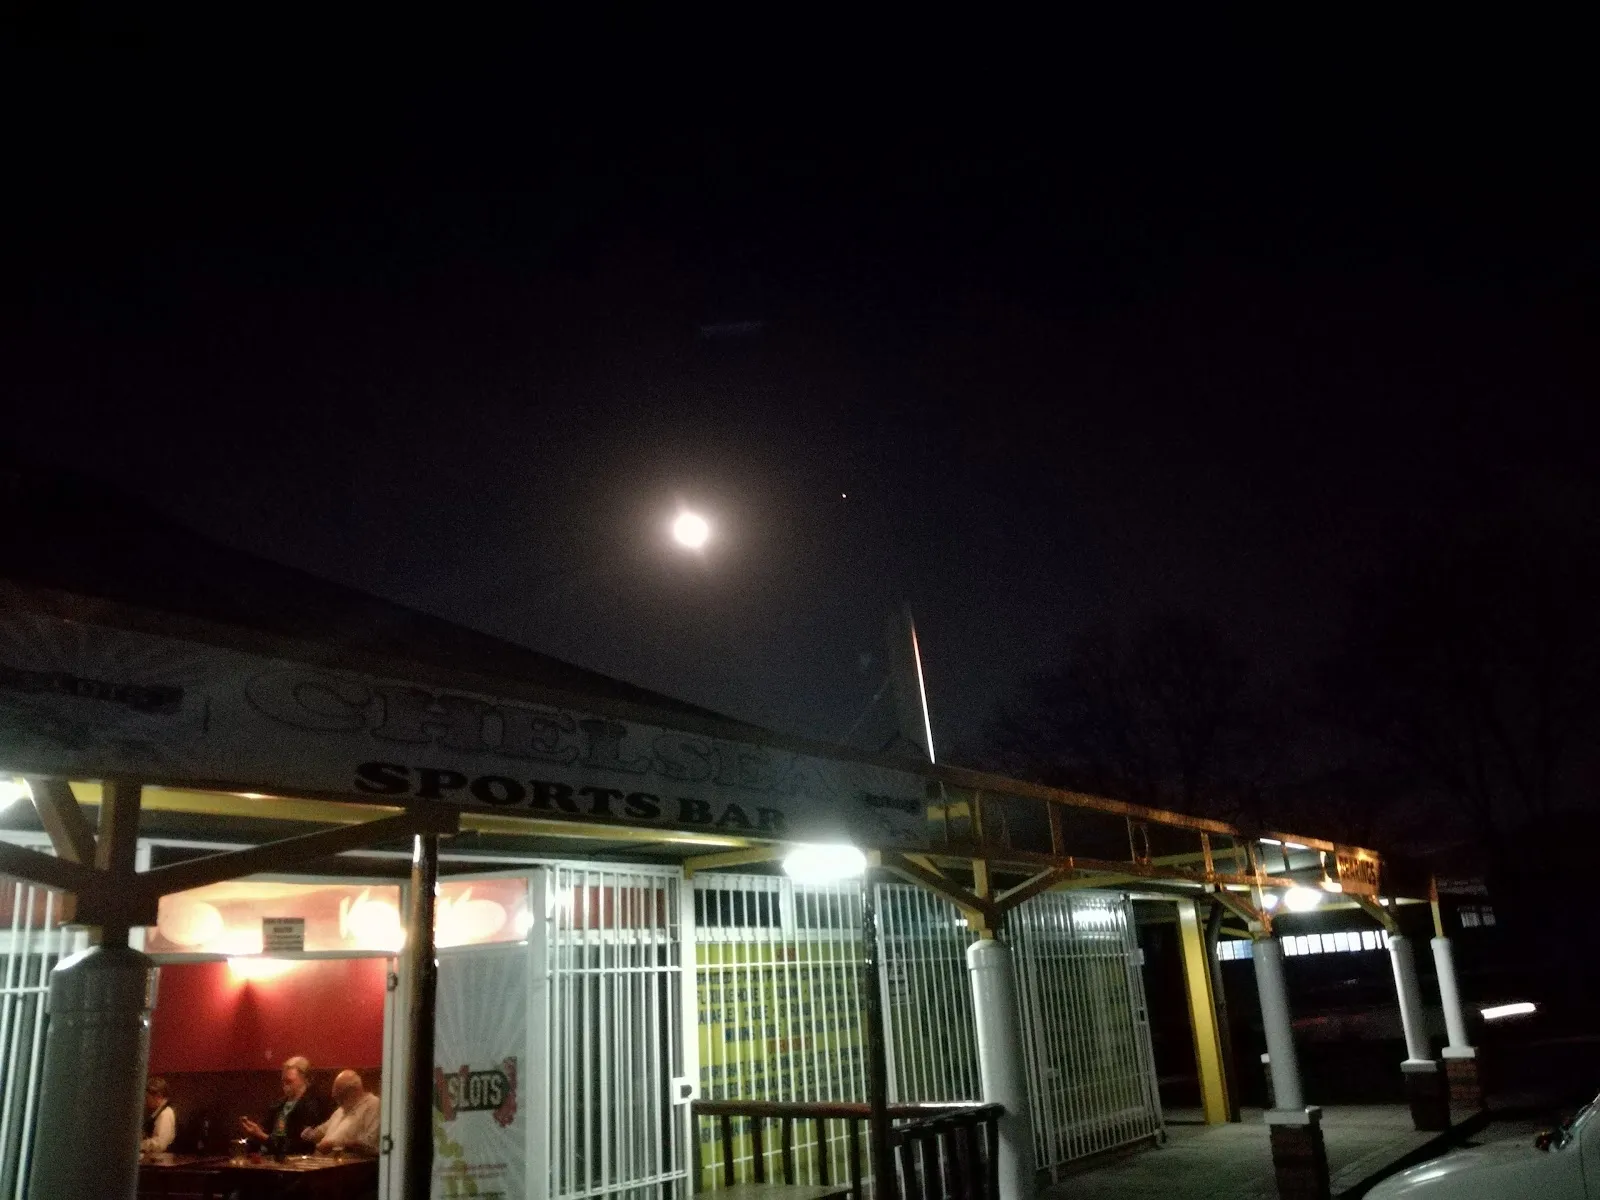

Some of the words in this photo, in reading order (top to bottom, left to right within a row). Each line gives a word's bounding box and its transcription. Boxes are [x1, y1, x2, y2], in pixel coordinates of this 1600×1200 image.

[246, 667, 841, 798] CHELSEA
[355, 762, 661, 819] SPORTS
[677, 798, 786, 831] BAR
[448, 1073, 503, 1108] SLOTS
